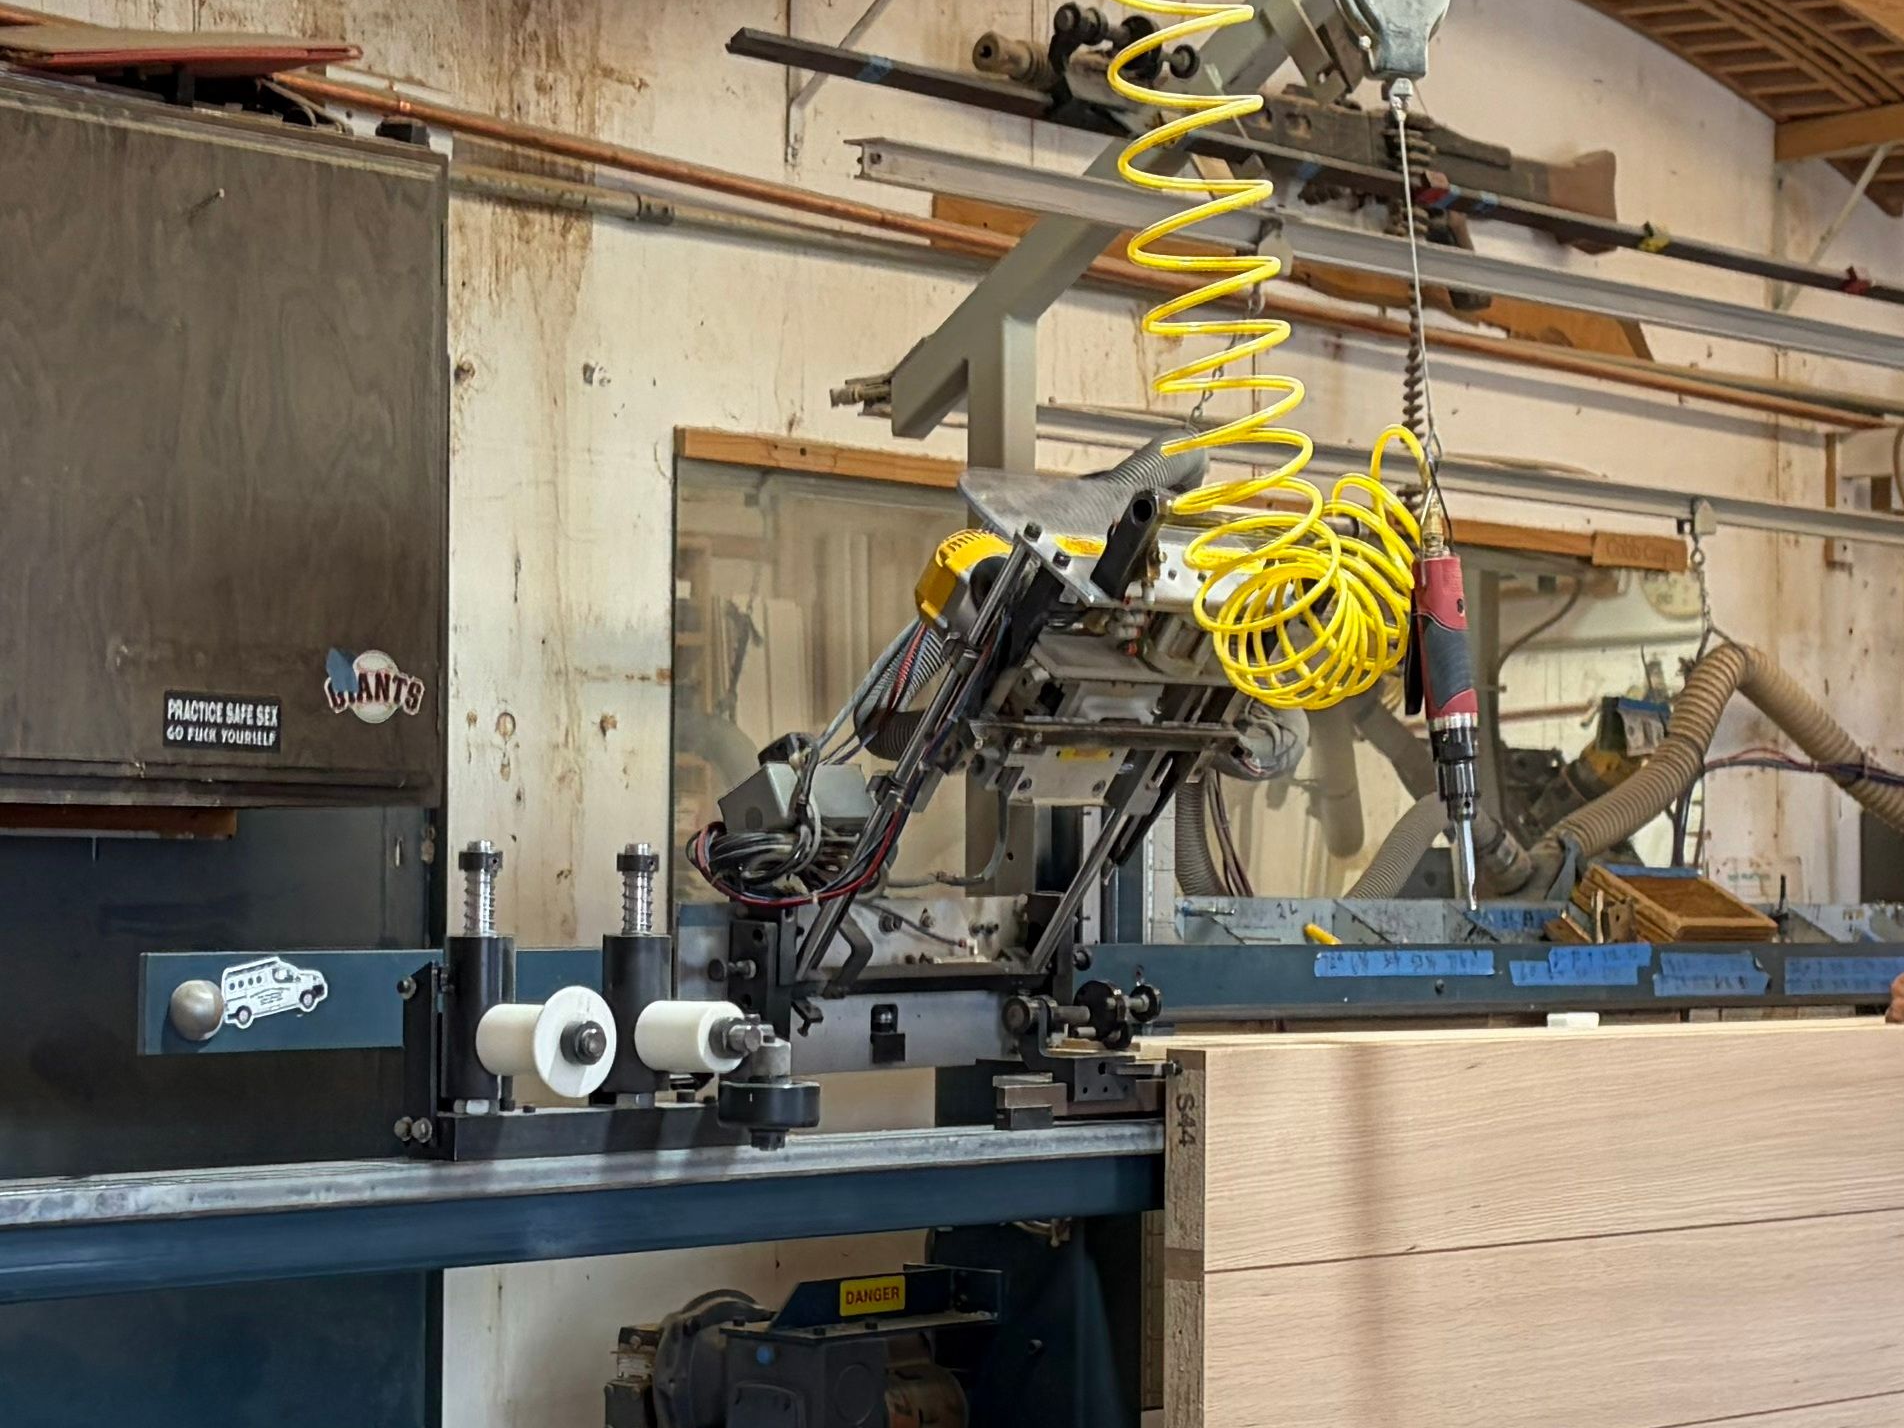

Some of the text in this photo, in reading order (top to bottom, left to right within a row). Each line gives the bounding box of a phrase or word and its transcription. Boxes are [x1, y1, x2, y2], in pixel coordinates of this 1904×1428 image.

[327, 671, 423, 712] ANTS
[167, 698, 279, 727] PRACTICE SAFE SEX
[166, 724, 184, 741] GO
[845, 1286, 900, 1306] DANGER
